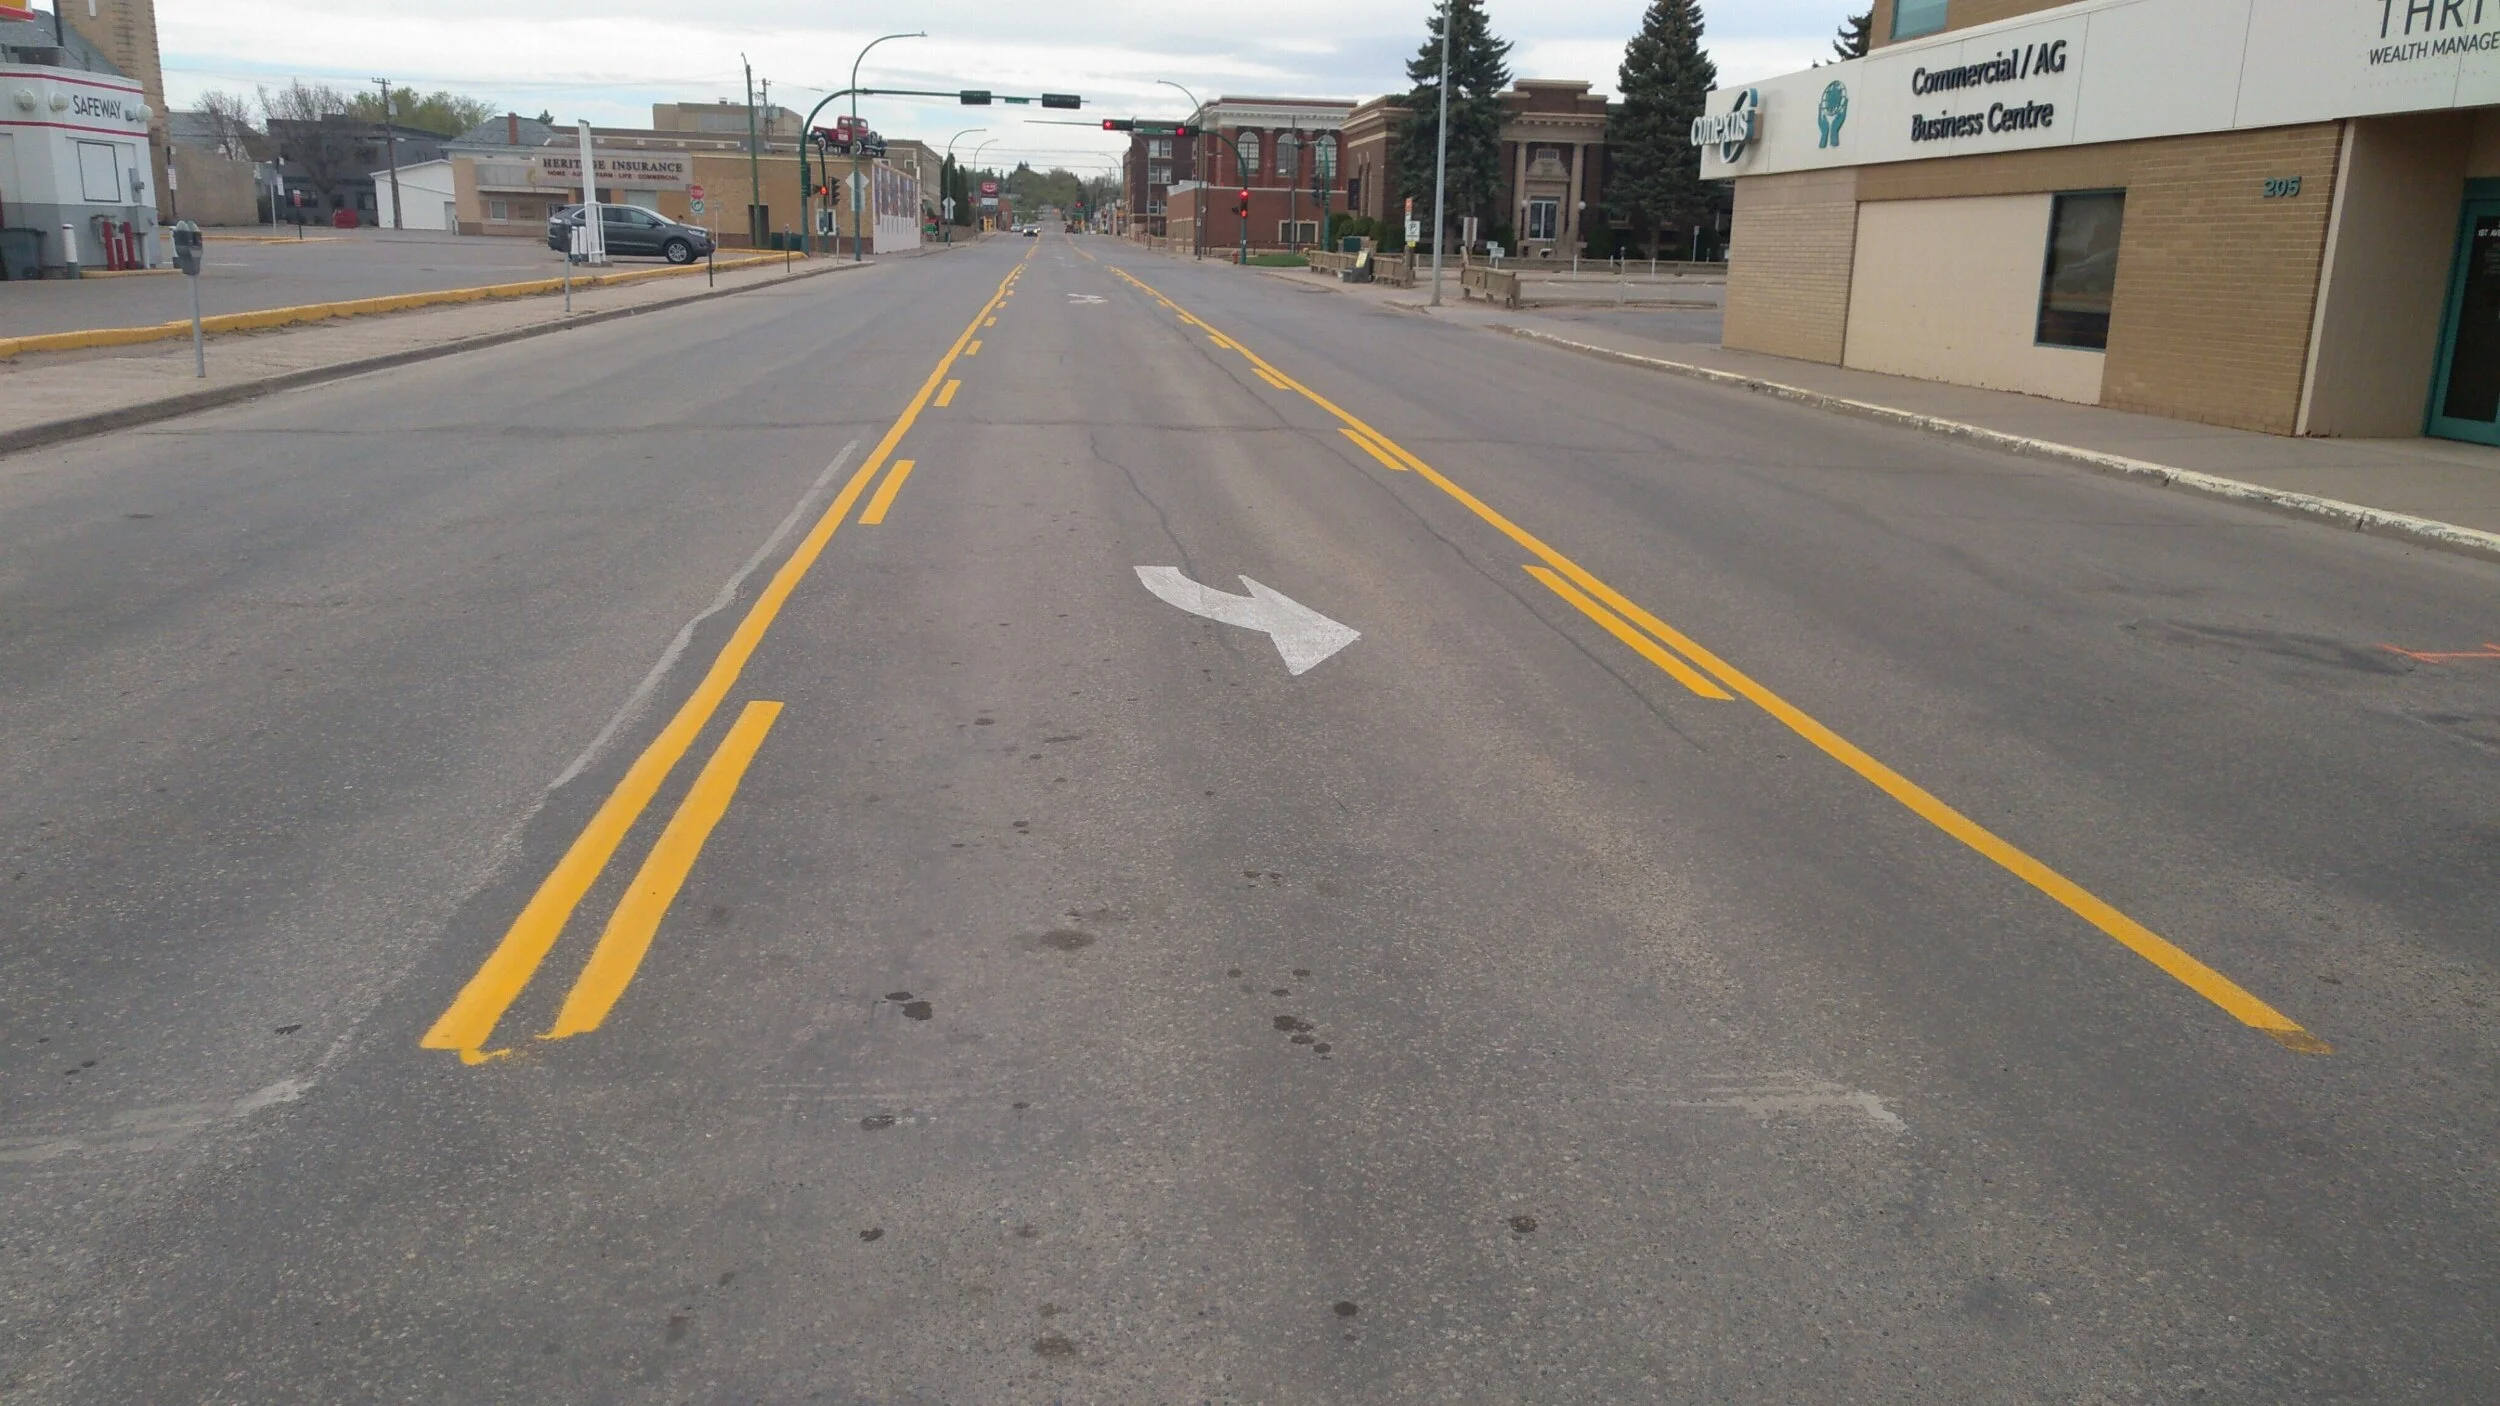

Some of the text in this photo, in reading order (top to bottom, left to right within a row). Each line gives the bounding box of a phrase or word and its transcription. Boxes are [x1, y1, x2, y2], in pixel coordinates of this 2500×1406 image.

[2377, 0, 2500, 38] THRI
[2369, 41, 2428, 65] WEALTH
[1912, 48, 2019, 96] Commercial
[2033, 39, 2067, 76] AG
[73, 94, 121, 119] SAFEWAY
[1911, 100, 2054, 142] Business Centre
[547, 170, 566, 178] HOME
[618, 172, 633, 180] LIFE
[638, 173, 680, 182] COMMERCIAL
[612, 160, 683, 173] INSURANCE
[2263, 176, 2301, 197] 205
